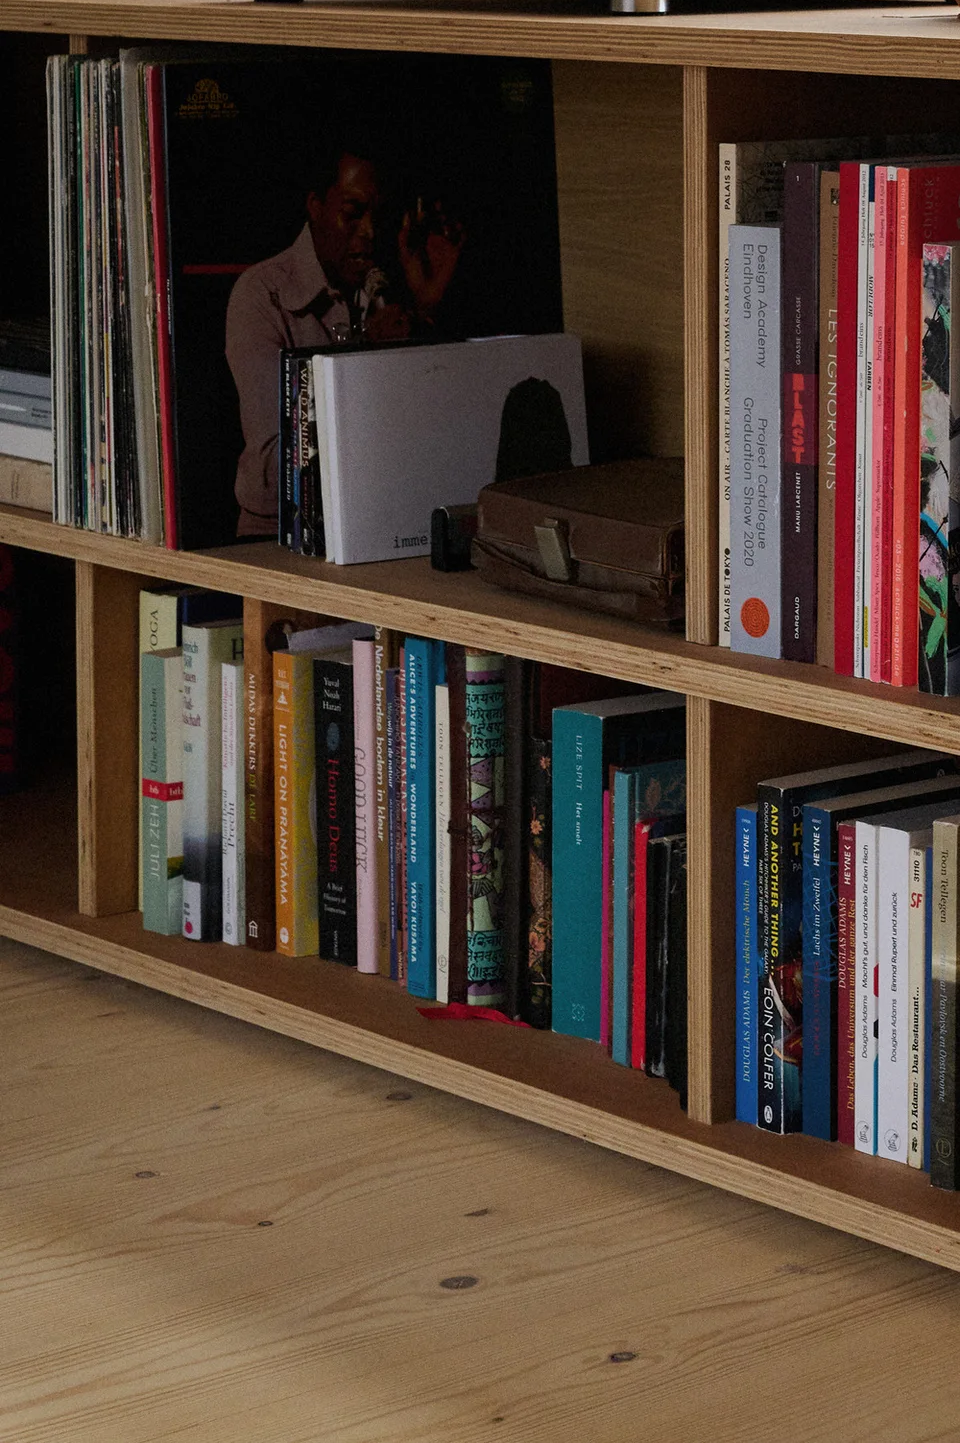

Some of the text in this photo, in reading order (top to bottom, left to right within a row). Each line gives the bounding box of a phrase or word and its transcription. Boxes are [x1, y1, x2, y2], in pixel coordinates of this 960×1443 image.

[724, 160, 731, 171] 28
[743, 244, 754, 319] Eindhoven
[756, 245, 768, 368] Design Academy
[301, 368, 310, 467] WILD ANIMUS
[743, 397, 755, 567] Graduation Show 2020
[756, 418, 768, 549] Project Catalogue
[375, 645, 384, 731] Nederlandse
[375, 737, 384, 785] bodem
[375, 789, 384, 802] in
[575, 735, 583, 790] LIZE SPIT
[150, 805, 160, 877] JULI ZEH
[328, 759, 340, 873] Homo Deus
[375, 806, 384, 841] kleur
[575, 802, 583, 845] Het smelt
[812, 833, 821, 867] HEYNE
[769, 804, 779, 977] AND ANOTHER THING...
[843, 851, 851, 885] HEYNE
[939, 849, 949, 923] Toon Tellegen
[890, 892, 898, 1063] Douglas Adams Einmal Rupert und zurück
[938, 994, 948, 1034] Pavlovsk
[742, 990, 750, 1082] DOUGLAS ADAMS
[762, 987, 774, 1090] EOIN COLFER
[938, 1036, 948, 1048] en
[938, 1050, 948, 1103] Oostvoorne
